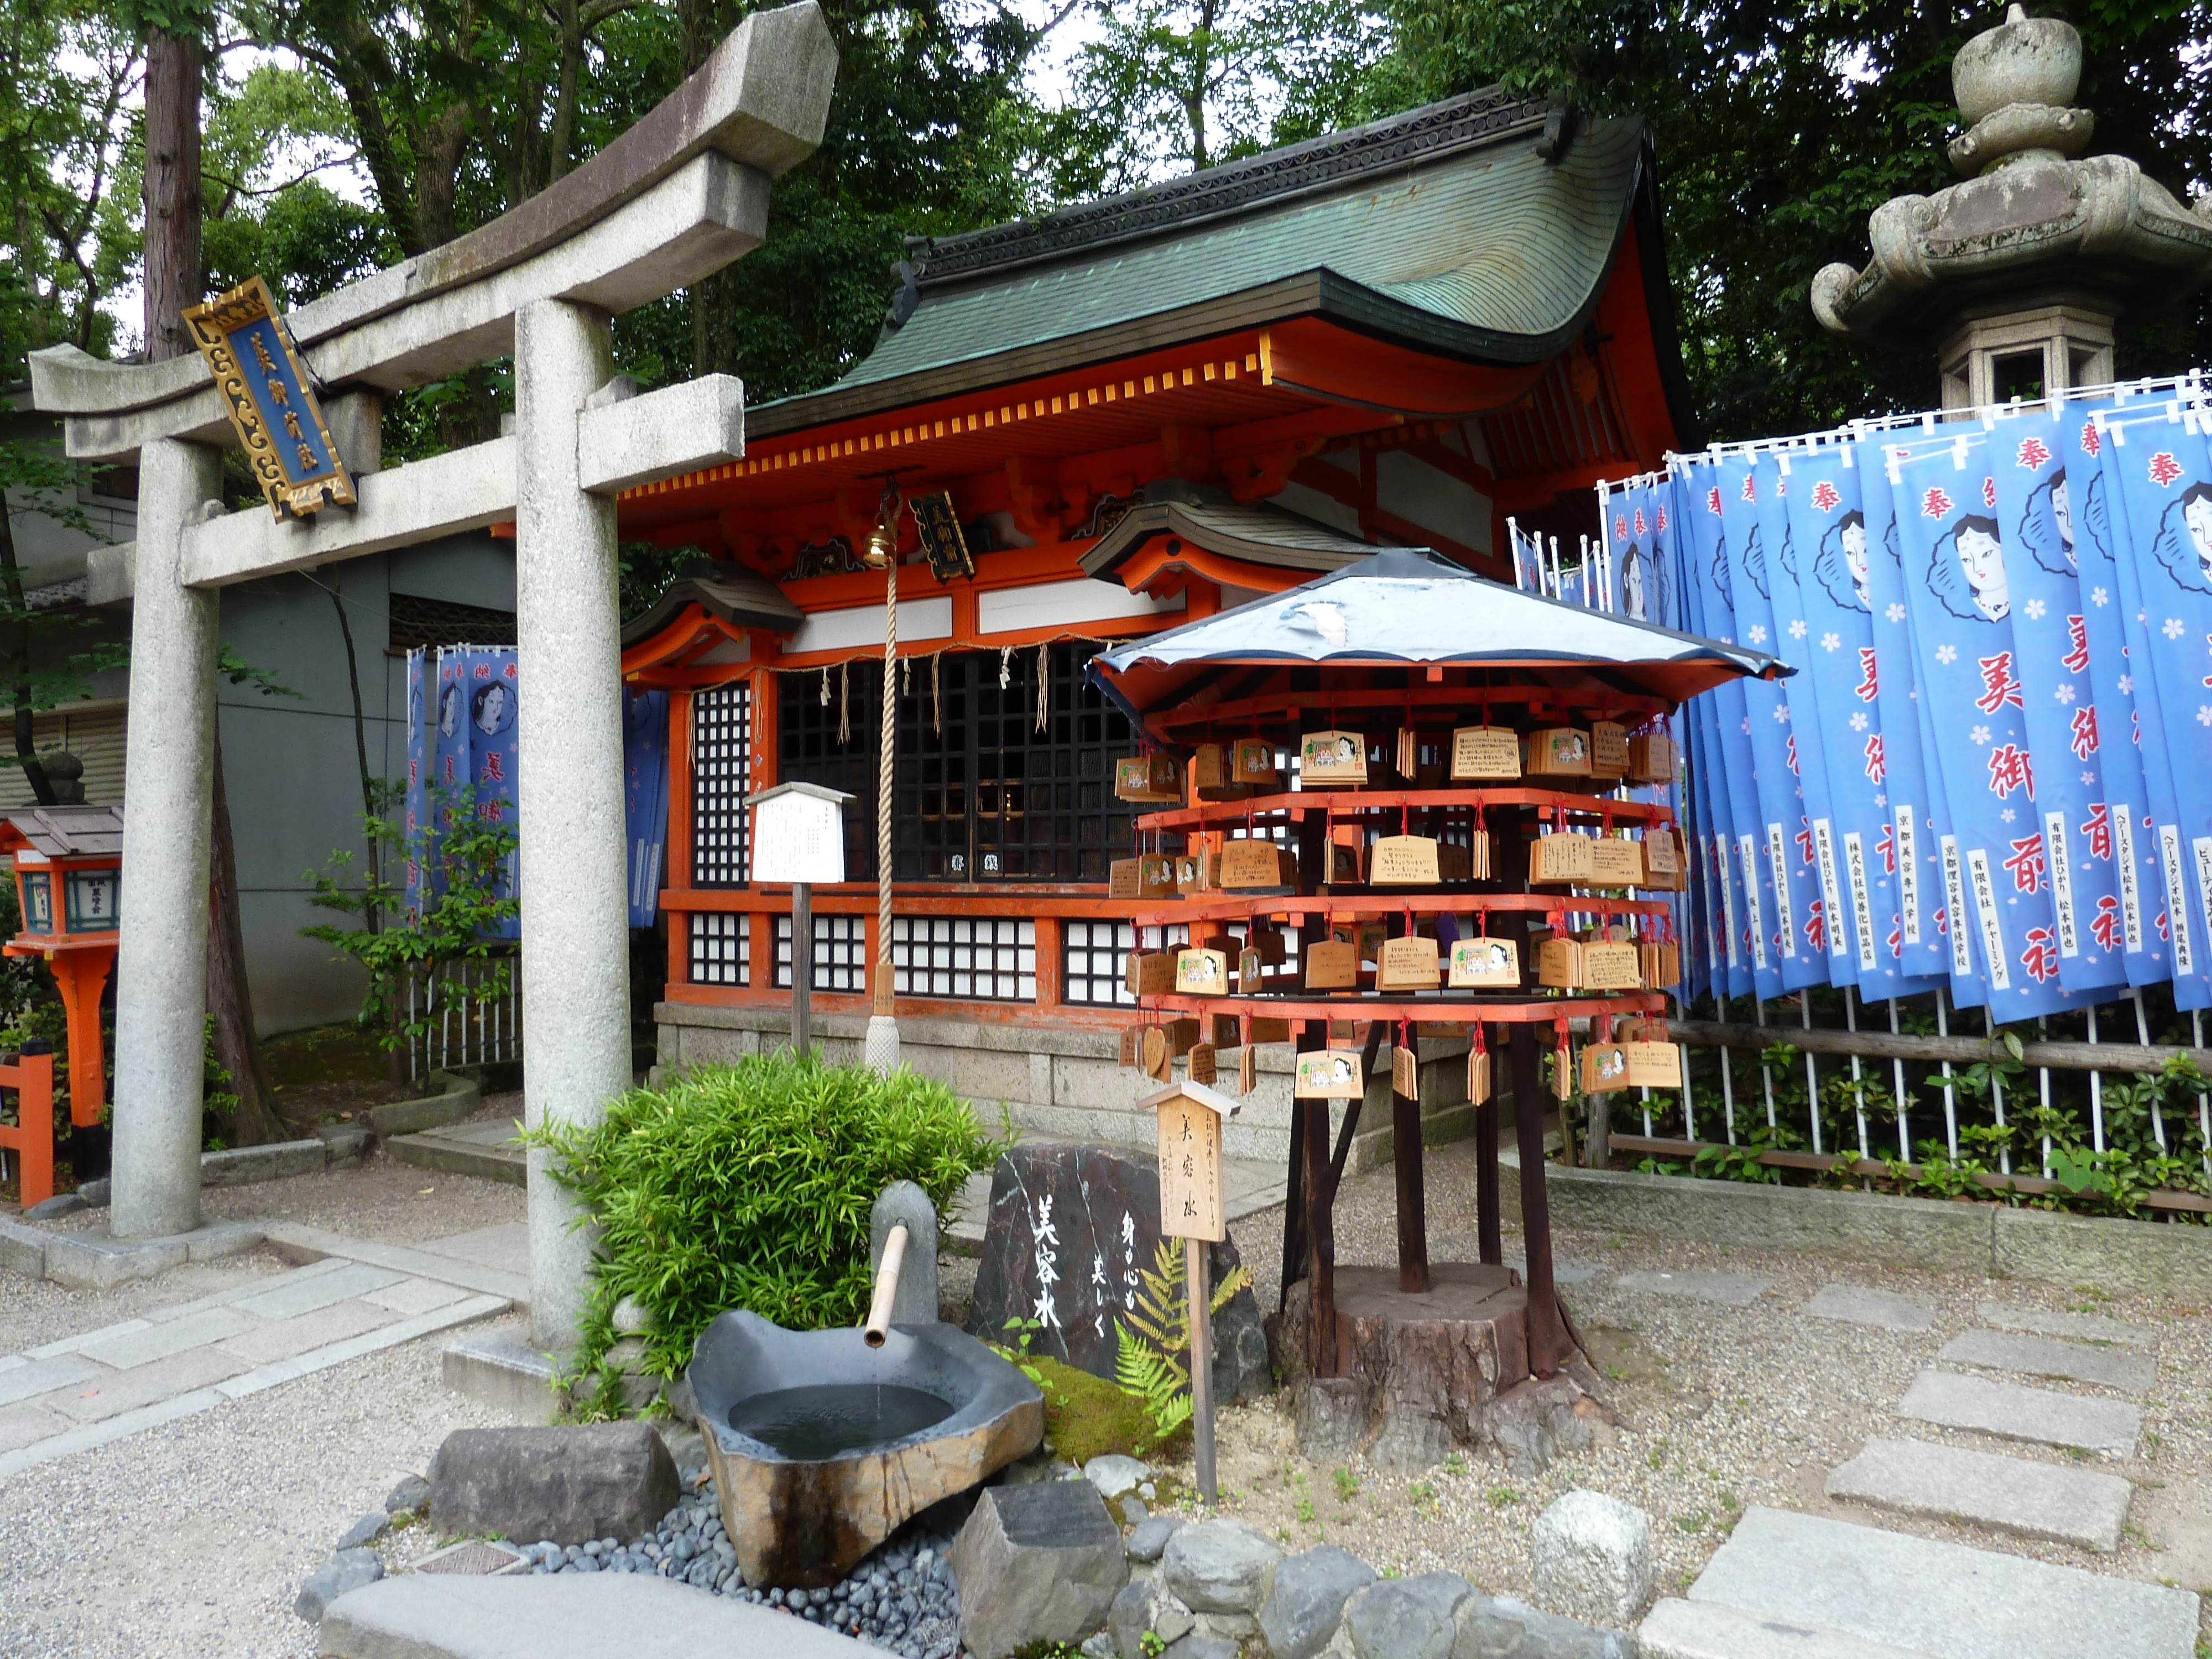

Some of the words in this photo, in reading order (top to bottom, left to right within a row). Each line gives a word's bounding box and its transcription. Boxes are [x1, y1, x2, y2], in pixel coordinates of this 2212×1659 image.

[2016, 437, 2052, 471] 奉
[2148, 452, 2184, 487] 奉
[1812, 481, 1842, 513] 奉
[1922, 487, 1954, 520] 奉
[1772, 832, 1785, 898] 有限会社ひかり
[1818, 828, 1833, 895] 有限会社ひかり
[1899, 815, 1917, 935] 京都美容専門学校
[2051, 822, 2066, 894] 有限会社ひかり
[2059, 899, 2074, 948] 松本慎也
[2116, 815, 2132, 895] ヘアースタジオ松本
[1971, 859, 1992, 909] 有限会社
[1984, 919, 2005, 980] チャーミング
[1180, 1113, 1197, 1218] 美容水
[1034, 1193, 1062, 1328] 美容水
[1092, 1253, 1107, 1338] 美しく
[1121, 1209, 1140, 1310] 身も心も
